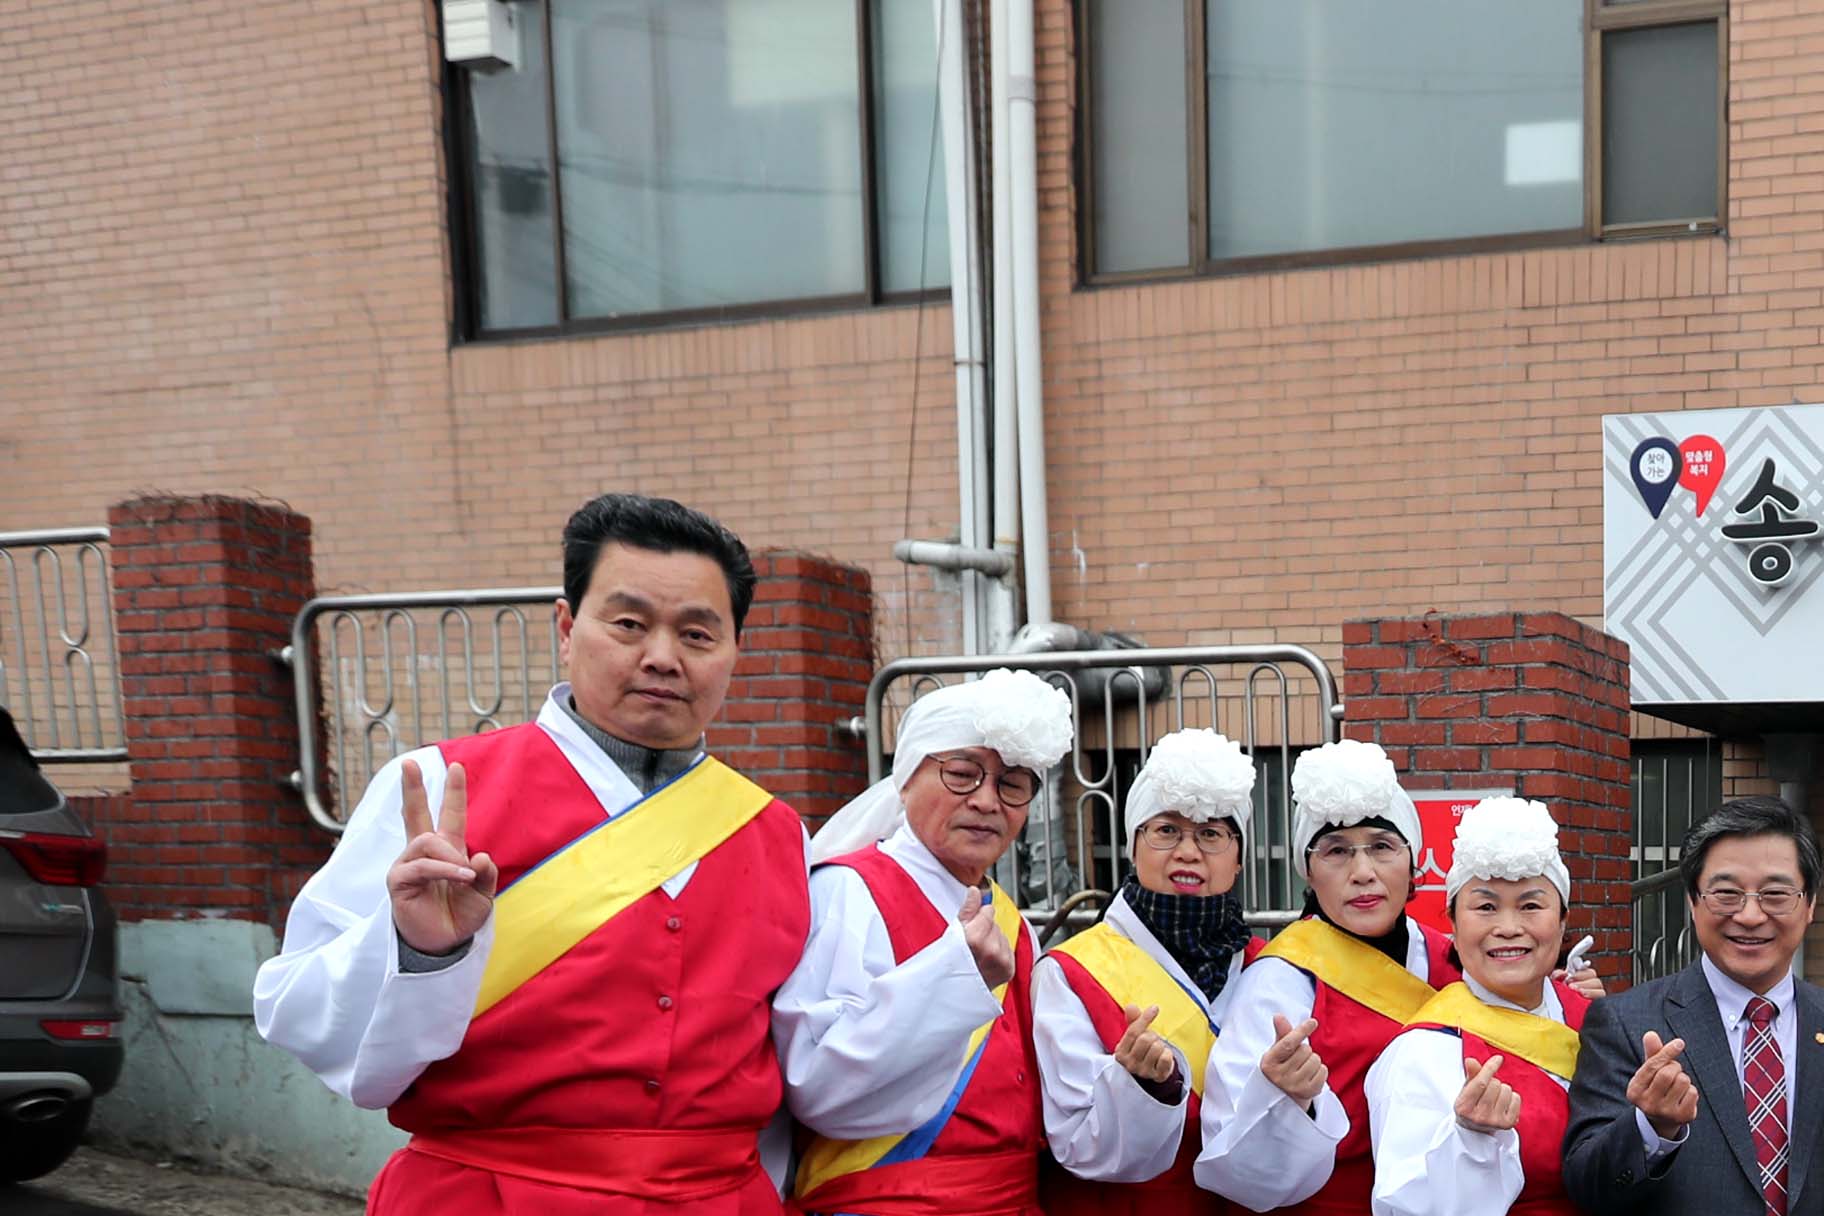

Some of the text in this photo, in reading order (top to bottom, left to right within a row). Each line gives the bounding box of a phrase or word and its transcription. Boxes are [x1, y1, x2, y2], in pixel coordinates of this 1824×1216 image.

[1647, 453, 1665, 465] 찾아
[1647, 466, 1665, 478] 가는
[1689, 463, 1709, 476] 복지
